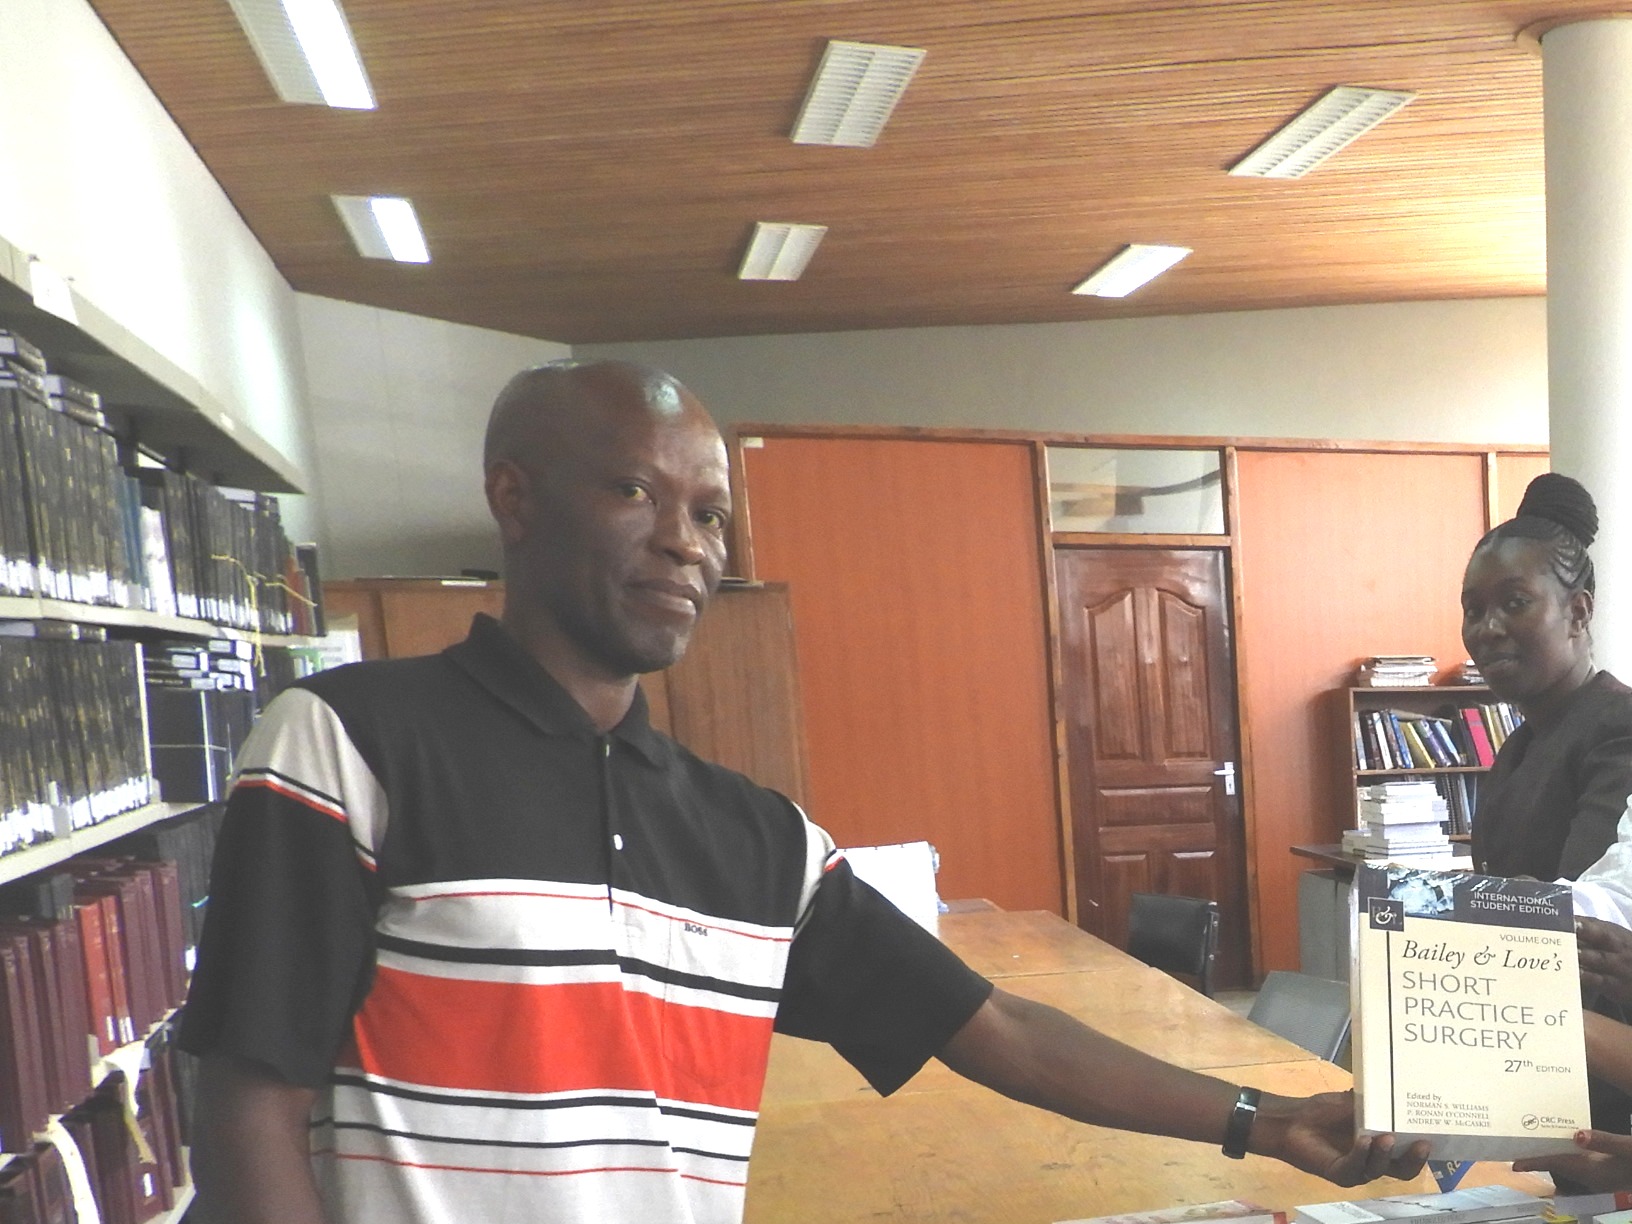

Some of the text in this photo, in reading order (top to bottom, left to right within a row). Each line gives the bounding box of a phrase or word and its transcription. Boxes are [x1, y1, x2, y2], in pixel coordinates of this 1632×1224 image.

[1474, 891, 1554, 906] INTERNATIONAL
[1470, 900, 1559, 916] STUDENT EDITION
[684, 923, 707, 936] BOSS
[1500, 934, 1562, 945] VOLUME ONE
[1402, 940, 1562, 972] Bailey & Love's
[1403, 971, 1497, 995] SHORT
[1405, 997, 1568, 1026] PRACTICE of
[1404, 1023, 1528, 1050] SURGERY
[1504, 1059, 1571, 1074] 27th EDITION
[1432, 1093, 1441, 1101] by
[1407, 1101, 1442, 1109] NORMAN
[1540, 1116, 1555, 1124] CRC
